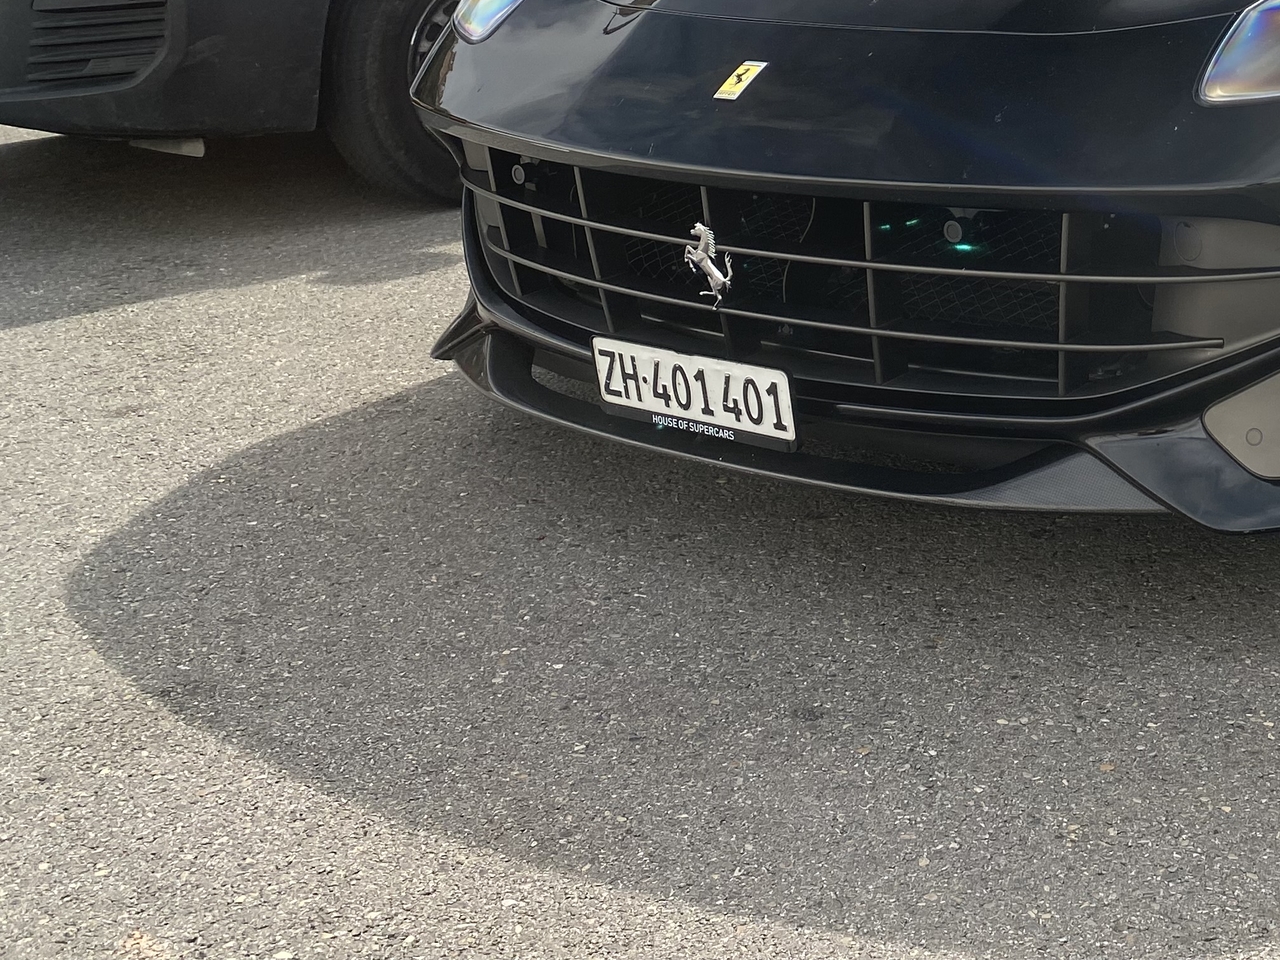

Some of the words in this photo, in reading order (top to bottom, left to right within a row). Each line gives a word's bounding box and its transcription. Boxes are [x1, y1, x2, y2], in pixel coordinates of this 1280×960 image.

[652, 413, 678, 429] HOUSE
[677, 419, 689, 431] OF
[688, 421, 736, 441] SUPERCARS
